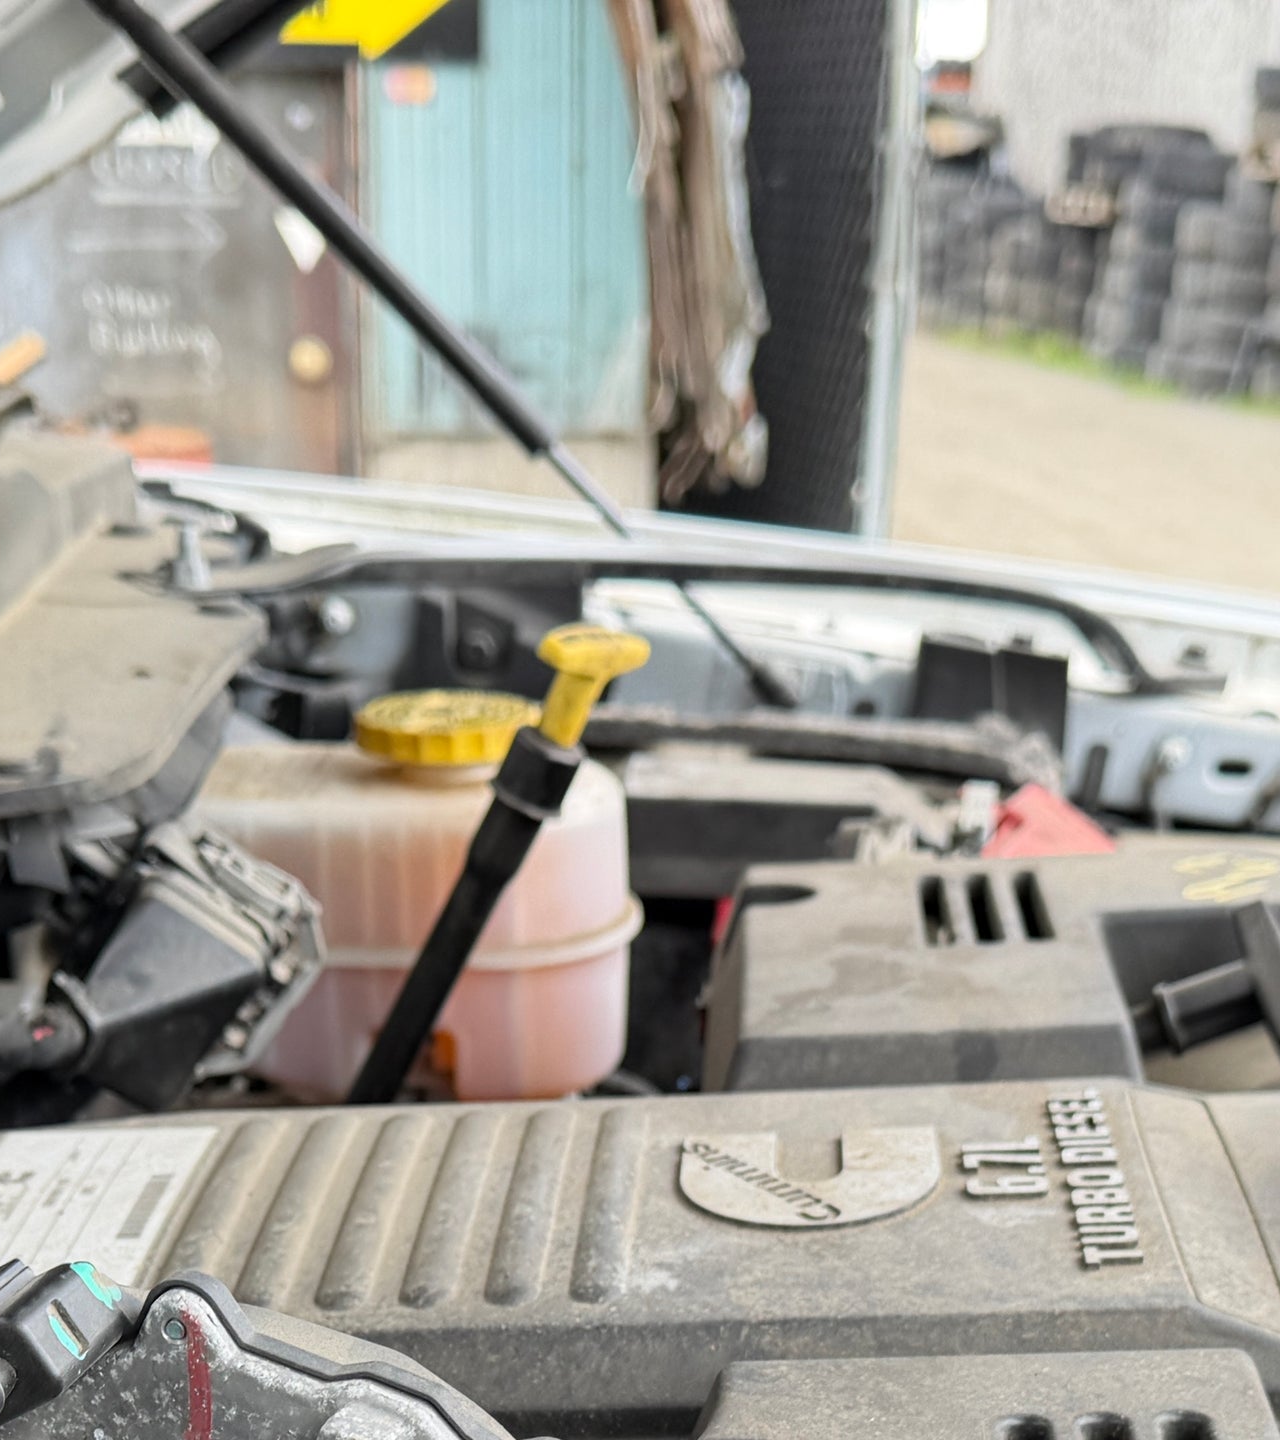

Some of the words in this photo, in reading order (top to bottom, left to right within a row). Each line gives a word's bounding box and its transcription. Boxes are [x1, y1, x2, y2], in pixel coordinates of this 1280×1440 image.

[1047, 1087, 1119, 1165] DIESEL
[686, 1142, 842, 1221] Cummins
[961, 1134, 1050, 1197] 6.7L
[1066, 1167, 1144, 1268] TURBO
